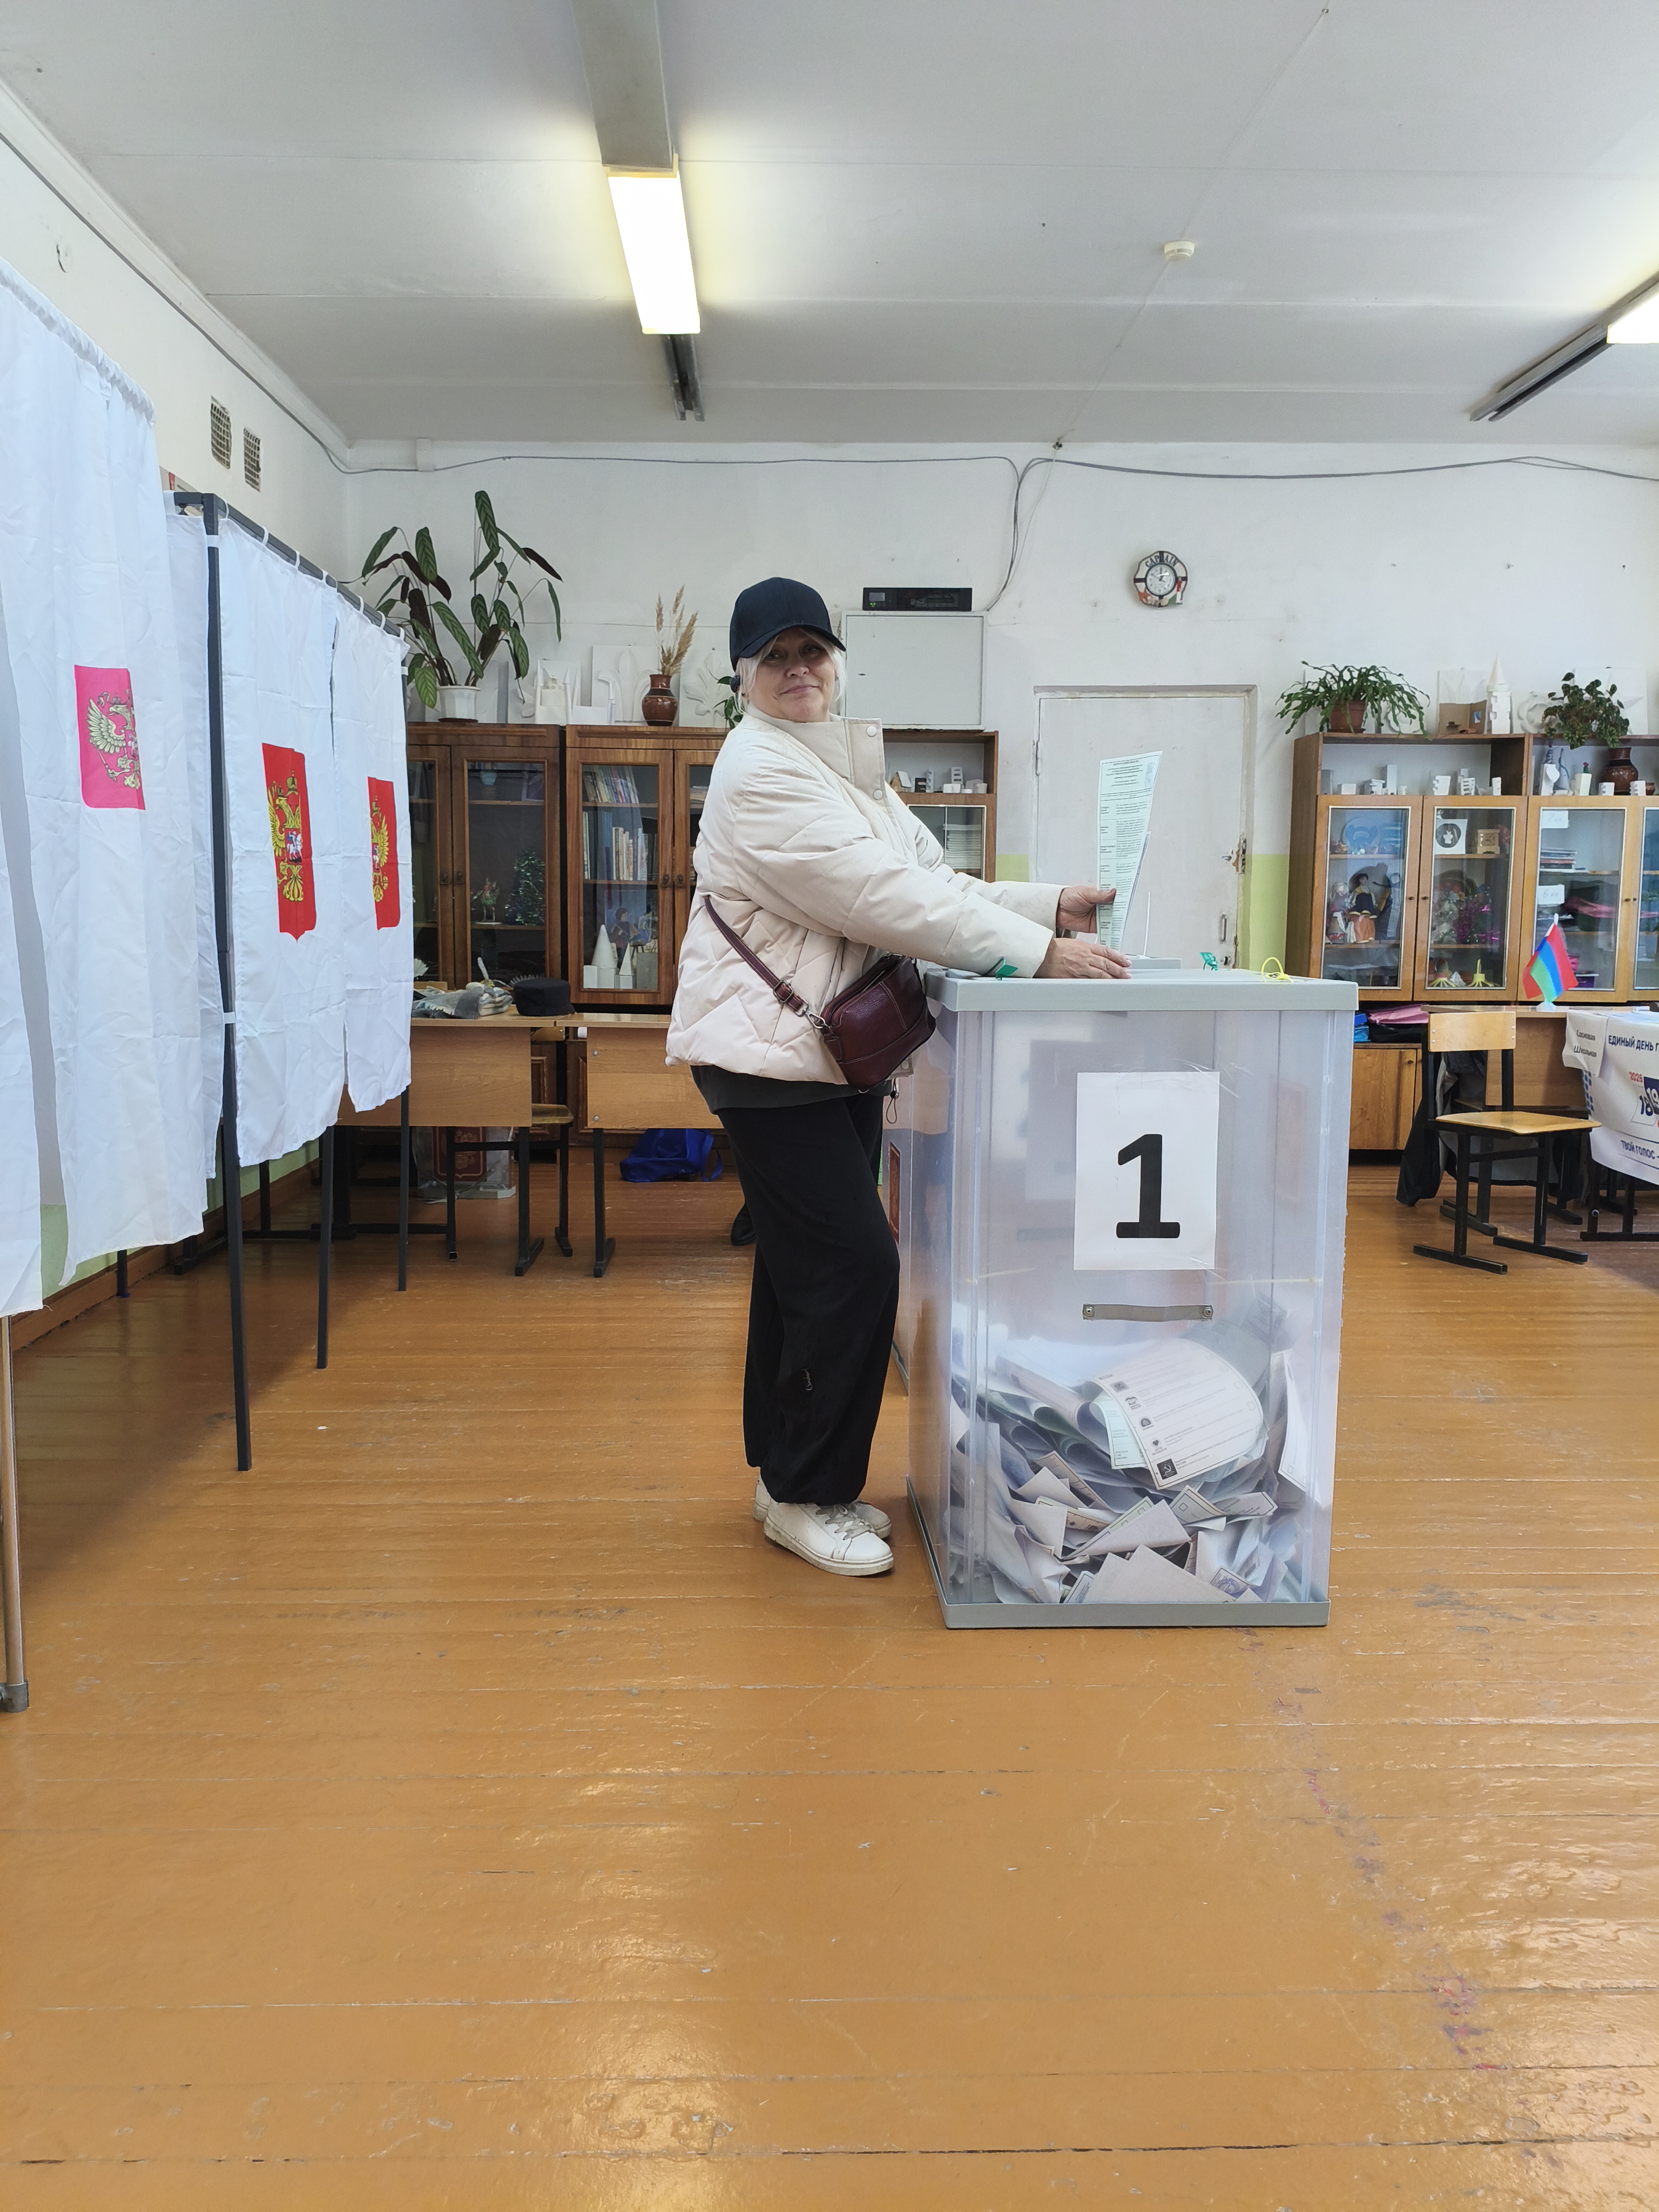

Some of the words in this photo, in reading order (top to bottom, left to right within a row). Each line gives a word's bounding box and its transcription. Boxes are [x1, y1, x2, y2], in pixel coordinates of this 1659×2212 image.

[1145, 555, 1178, 568] CAPAIN
[1608, 1034, 1635, 1048] ЕДИНЫЙ
[1635, 1040, 1654, 1051] ДЕНЬ
[1639, 1095, 1654, 1116] 18
[1621, 1139, 1635, 1154] ТВОЙ
[1635, 1145, 1655, 1159] ГОЛОС
[1116, 1134, 1181, 1238] 1
